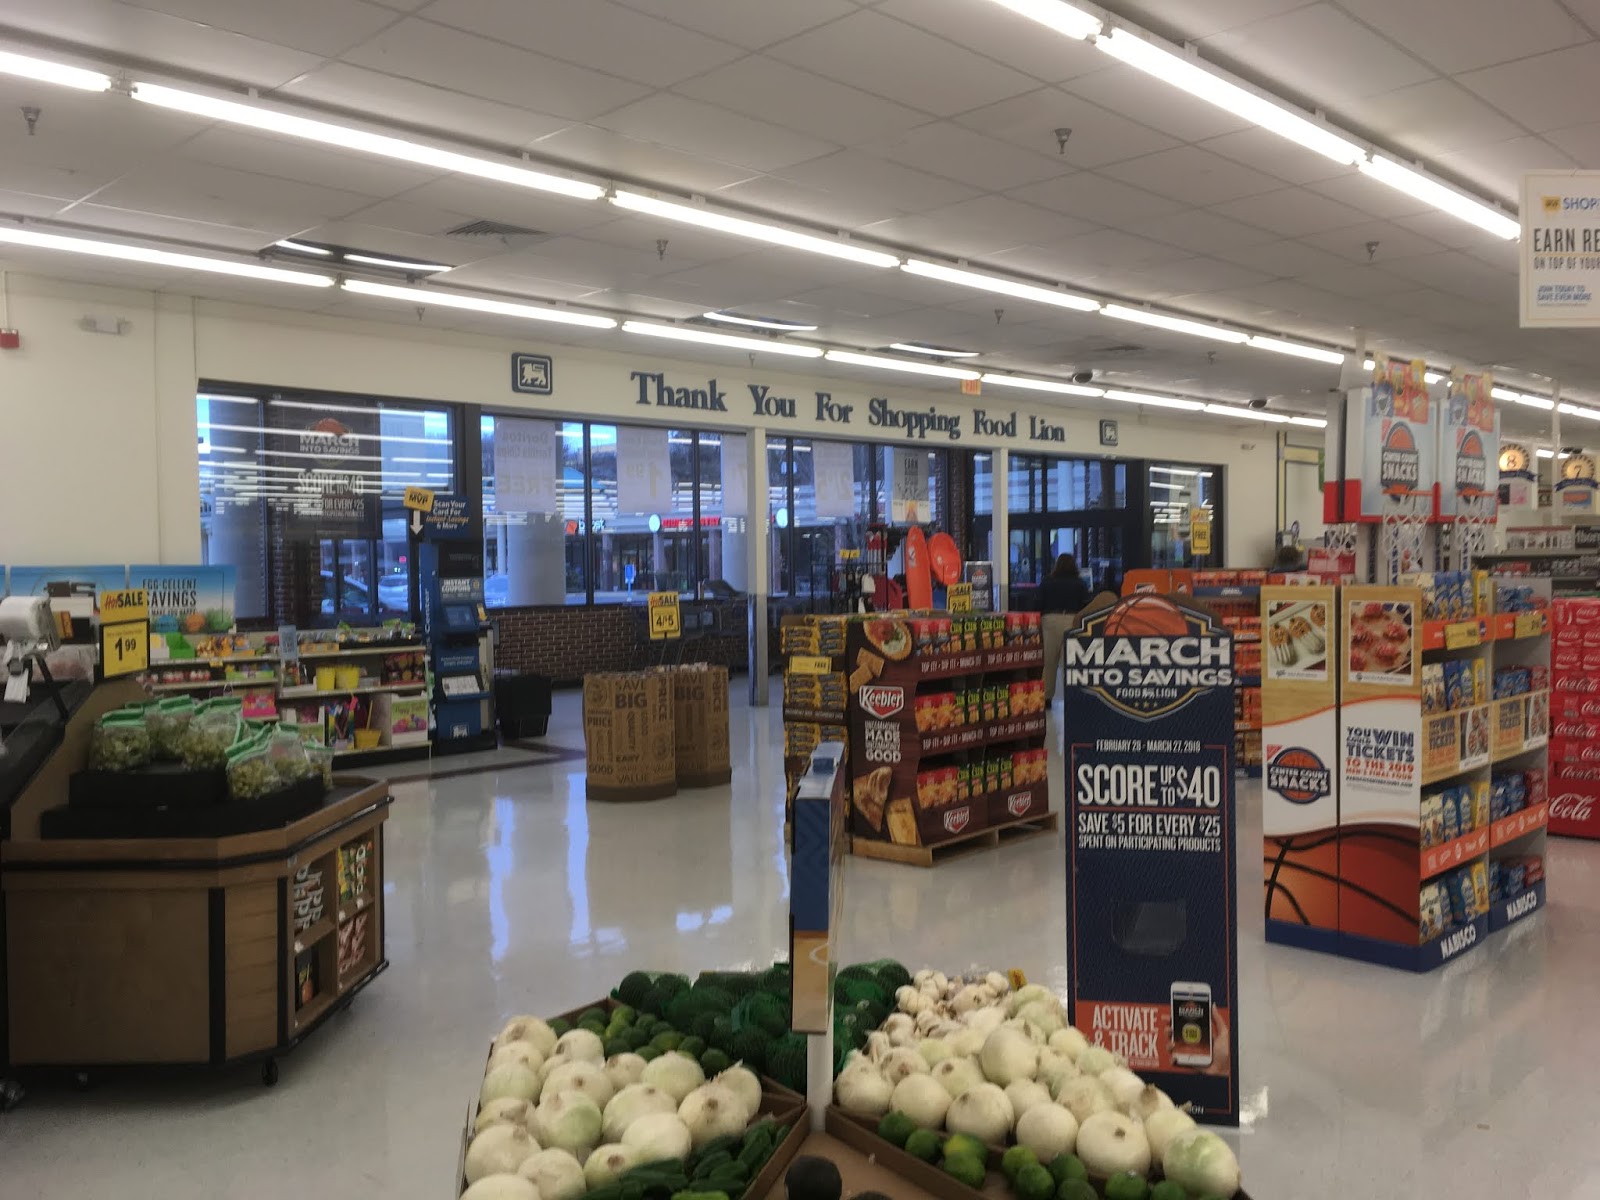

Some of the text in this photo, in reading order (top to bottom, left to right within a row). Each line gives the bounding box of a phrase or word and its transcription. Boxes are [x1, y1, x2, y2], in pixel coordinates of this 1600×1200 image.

[1534, 228, 1575, 252] EARN
[1534, 257, 1545, 269] ON
[1549, 257, 1564, 269] TOP
[630, 371, 1065, 442] Thank You For Shopping Food Lion
[300, 434, 359, 446] MARCH
[1382, 462, 1418, 480] SNACKS
[433, 508, 449, 516] Card
[434, 500, 466, 508] Scan Your
[118, 592, 143, 608] SALE
[1066, 636, 1231, 666] MARCH
[1066, 669, 1233, 686] INTO SAVINGS
[616, 693, 648, 709] BIG
[861, 687, 902, 711] Keebler
[1116, 687, 1178, 699] FOOD LION
[865, 729, 900, 742] MADE
[1347, 726, 1371, 737] YOU
[1373, 728, 1414, 748] WIN
[1096, 739, 1132, 752] FEBRUARY
[1147, 740, 1172, 752] MARCH
[1346, 743, 1415, 763] TICKETS
[866, 750, 901, 763] GOOD
[1346, 757, 1414, 772] TO THE 2019
[1270, 766, 1328, 779] CENTER COURT
[1077, 763, 1220, 808] SCORE UP TO $40
[1270, 775, 1328, 792] SNACKS
[1078, 813, 1221, 837] SAVE $5 FOR EVERY $25
[1078, 835, 1221, 852] SPENT ON PARTICIPATING PRODUCTS
[1506, 889, 1538, 921] NABISCO
[1441, 923, 1476, 960] NABISCO
[1092, 1004, 1159, 1032] ACTIVATE
[1109, 1031, 1160, 1059] TRACK
